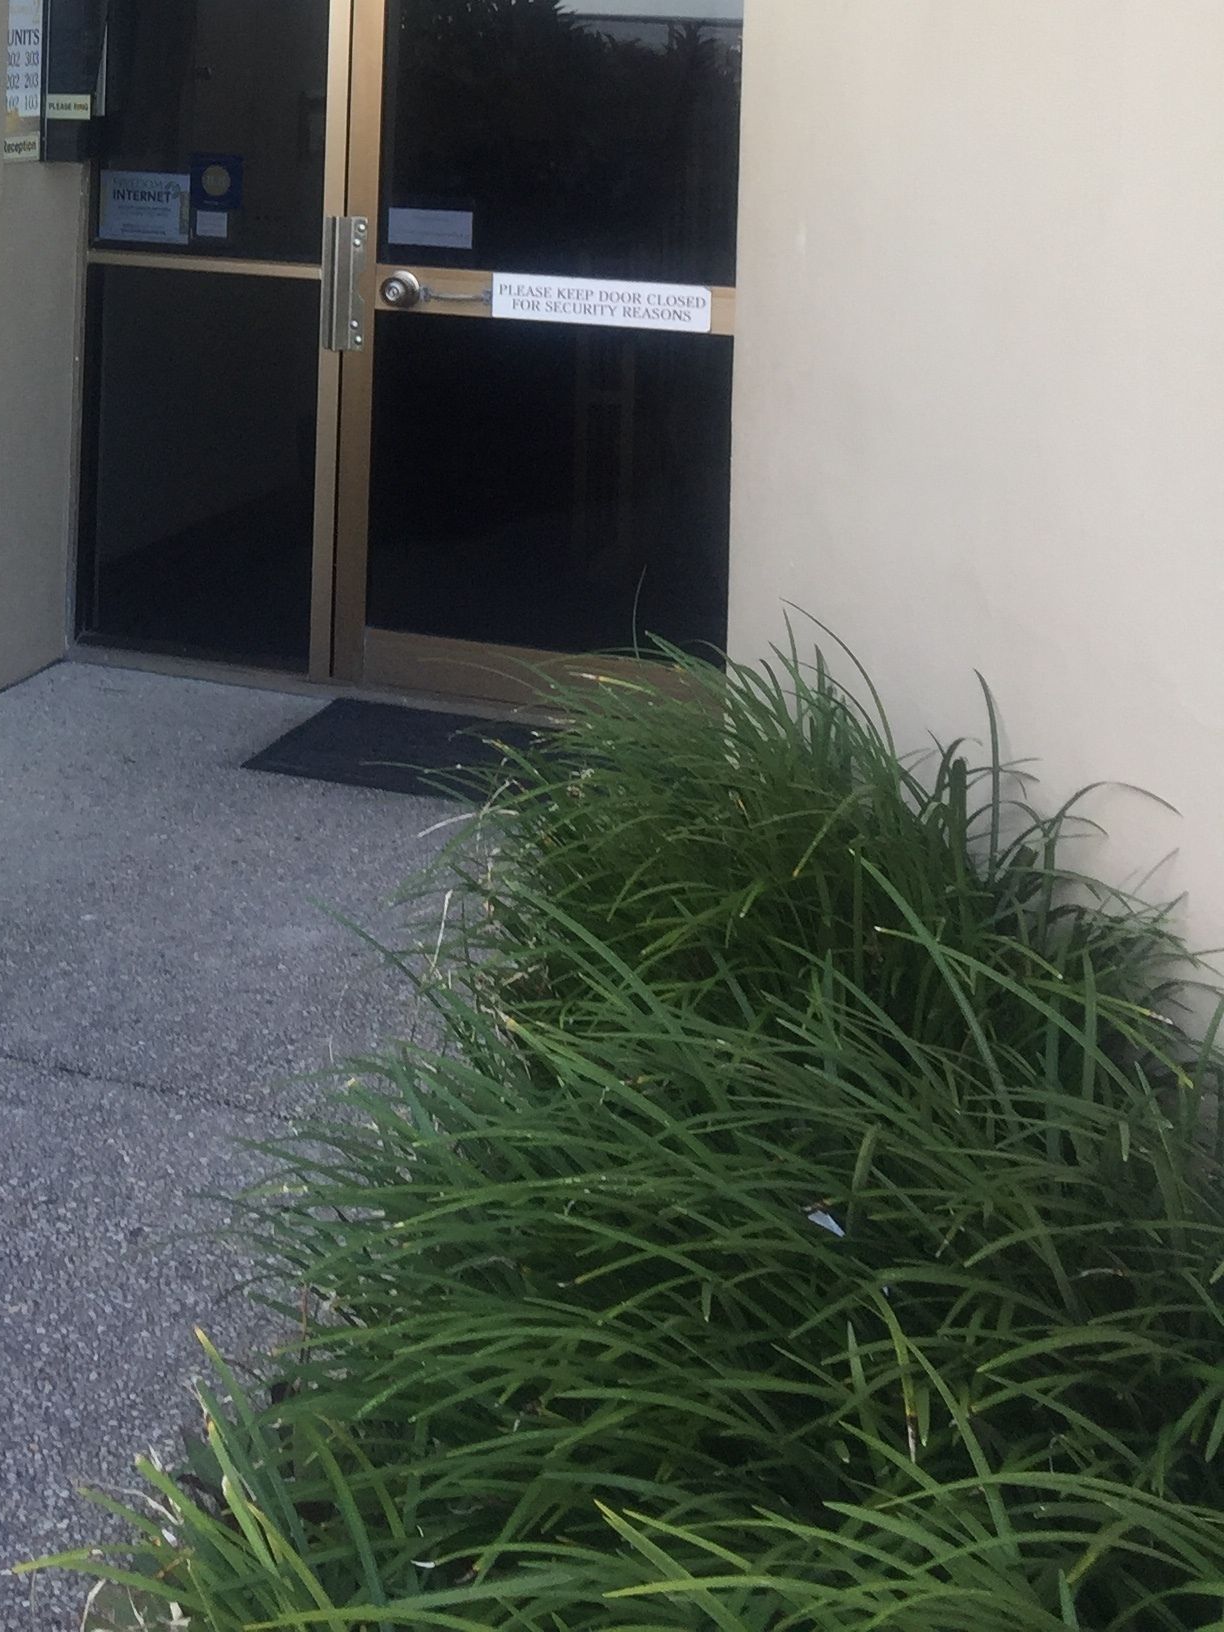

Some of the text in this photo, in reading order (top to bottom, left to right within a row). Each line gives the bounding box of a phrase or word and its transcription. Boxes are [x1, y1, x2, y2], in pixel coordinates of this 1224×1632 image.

[8, 28, 40, 46] UNITS
[24, 72, 39, 89] 203
[24, 94, 38, 111] 103
[48, 102, 72, 112] PLEASE
[112, 188, 171, 204] INTERNET
[498, 283, 707, 310] PLEASE KEEP DOOR CLOSED
[511, 298, 693, 323] FOR SECURITY REASONS
